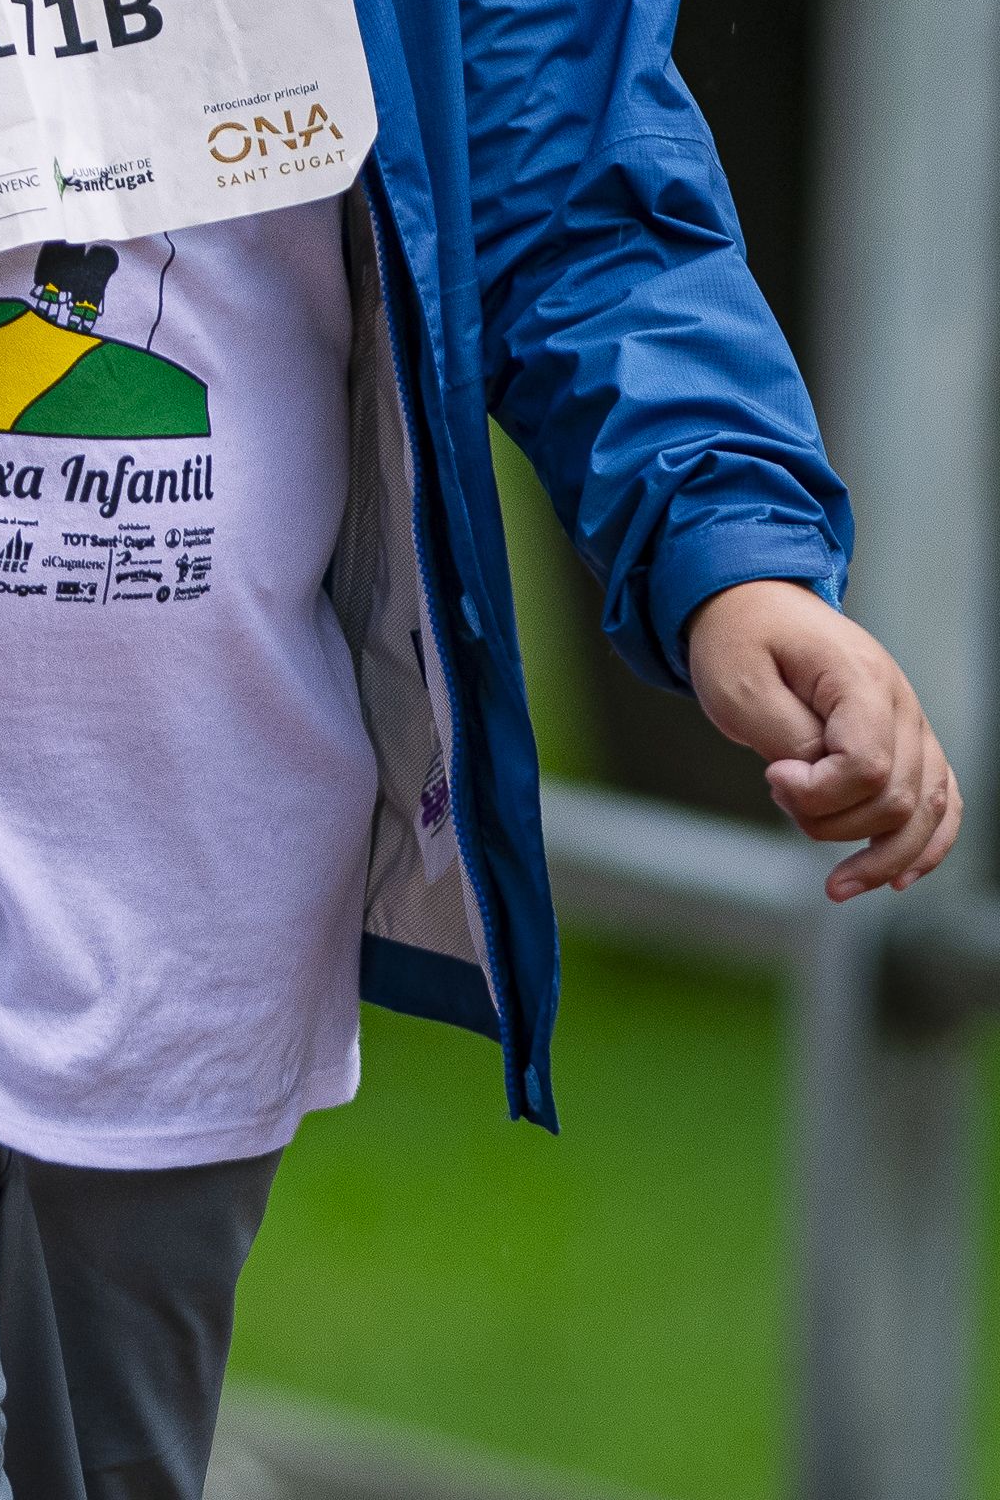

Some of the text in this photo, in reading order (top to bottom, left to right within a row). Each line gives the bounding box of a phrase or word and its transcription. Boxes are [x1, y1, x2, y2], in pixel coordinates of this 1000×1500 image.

[203, 81, 319, 115] Patrocinador principal
[208, 103, 343, 163] ONA
[75, 169, 155, 192] SantCugat
[137, 158, 152, 169] DE
[217, 149, 345, 188] SANT CUGAT
[61, 454, 214, 519] Infantil
